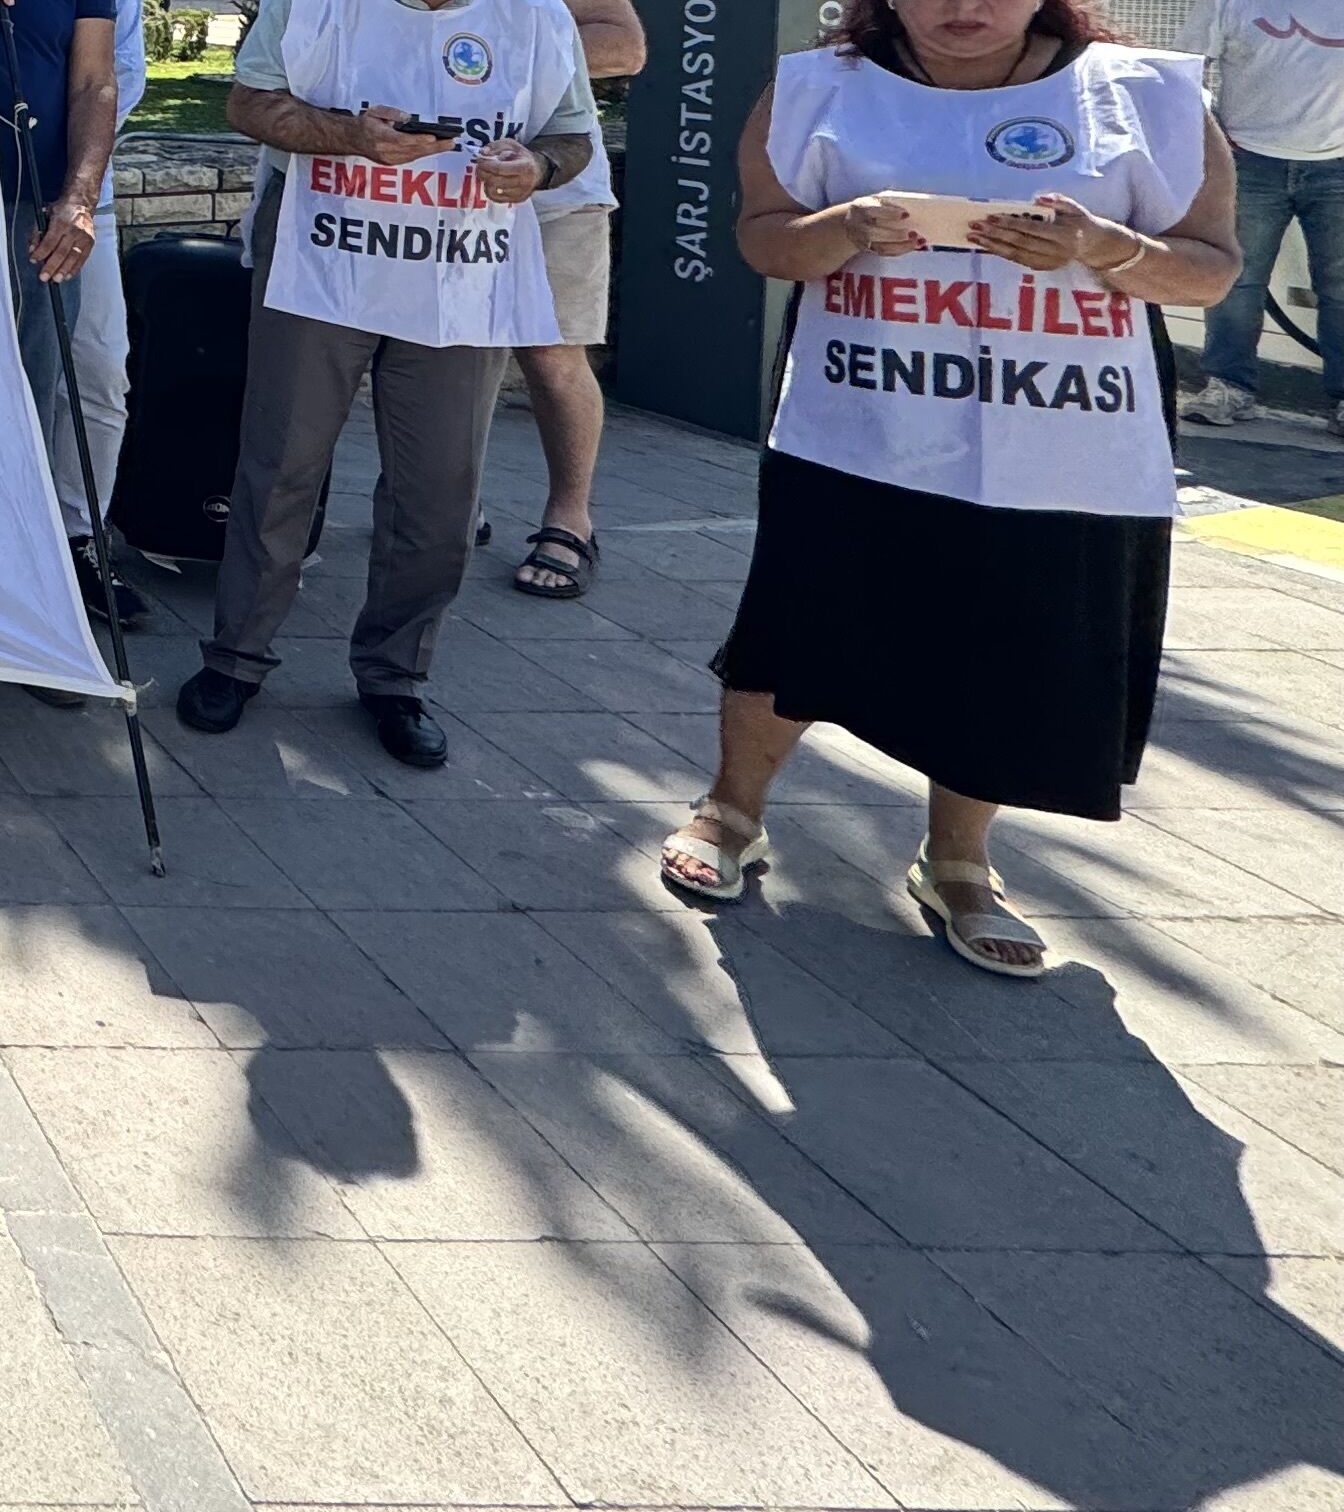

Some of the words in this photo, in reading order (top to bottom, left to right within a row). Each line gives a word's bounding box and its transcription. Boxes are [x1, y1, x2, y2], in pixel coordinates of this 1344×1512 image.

[310, 212, 511, 264] SENDİKAS
[674, 179, 714, 282] ŞARJ
[824, 270, 1135, 337] EMEKLİLER
[824, 339, 1136, 413] SENDİKASI
